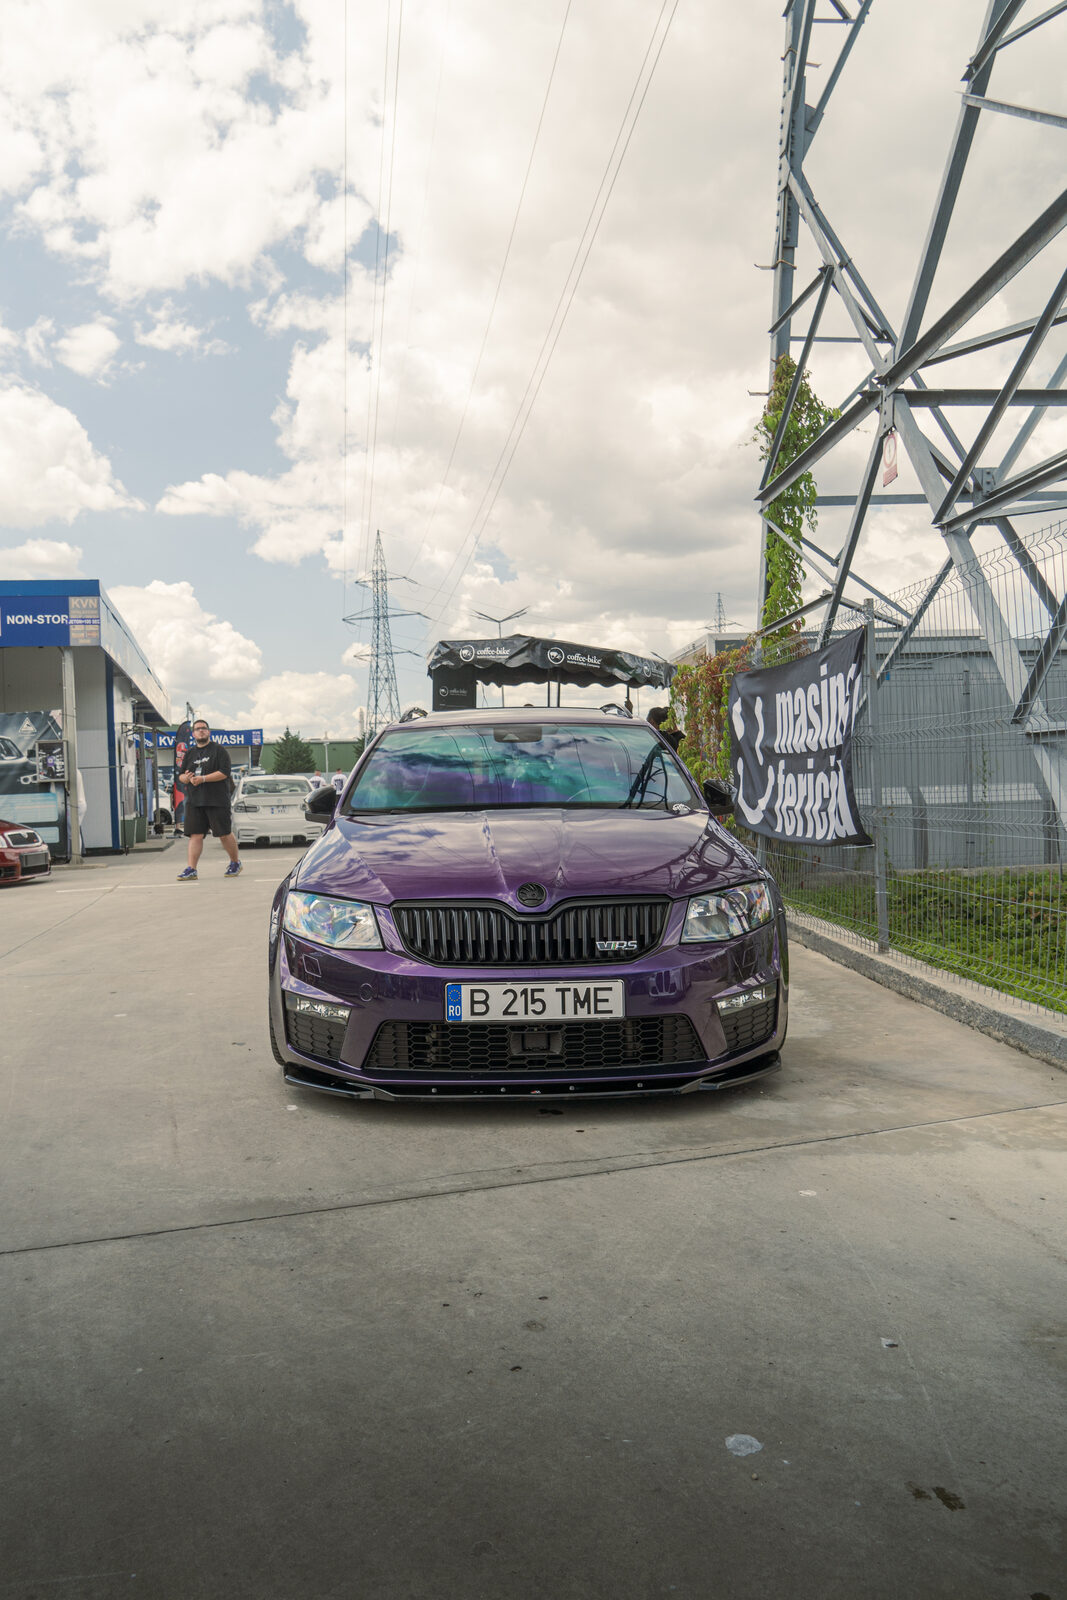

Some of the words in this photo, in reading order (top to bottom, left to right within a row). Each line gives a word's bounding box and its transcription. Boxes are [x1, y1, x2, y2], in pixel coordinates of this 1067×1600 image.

[71, 599, 98, 609] KVN
[476, 646, 510, 656] coffee-bike
[566, 653, 602, 665] coffee-bike
[159, 736, 176, 747] KV
[211, 734, 245, 745] WASH
[469, 988, 490, 1017] B
[502, 988, 547, 1016] 215
[556, 987, 613, 1016] TME
[448, 1005, 461, 1017] RO
